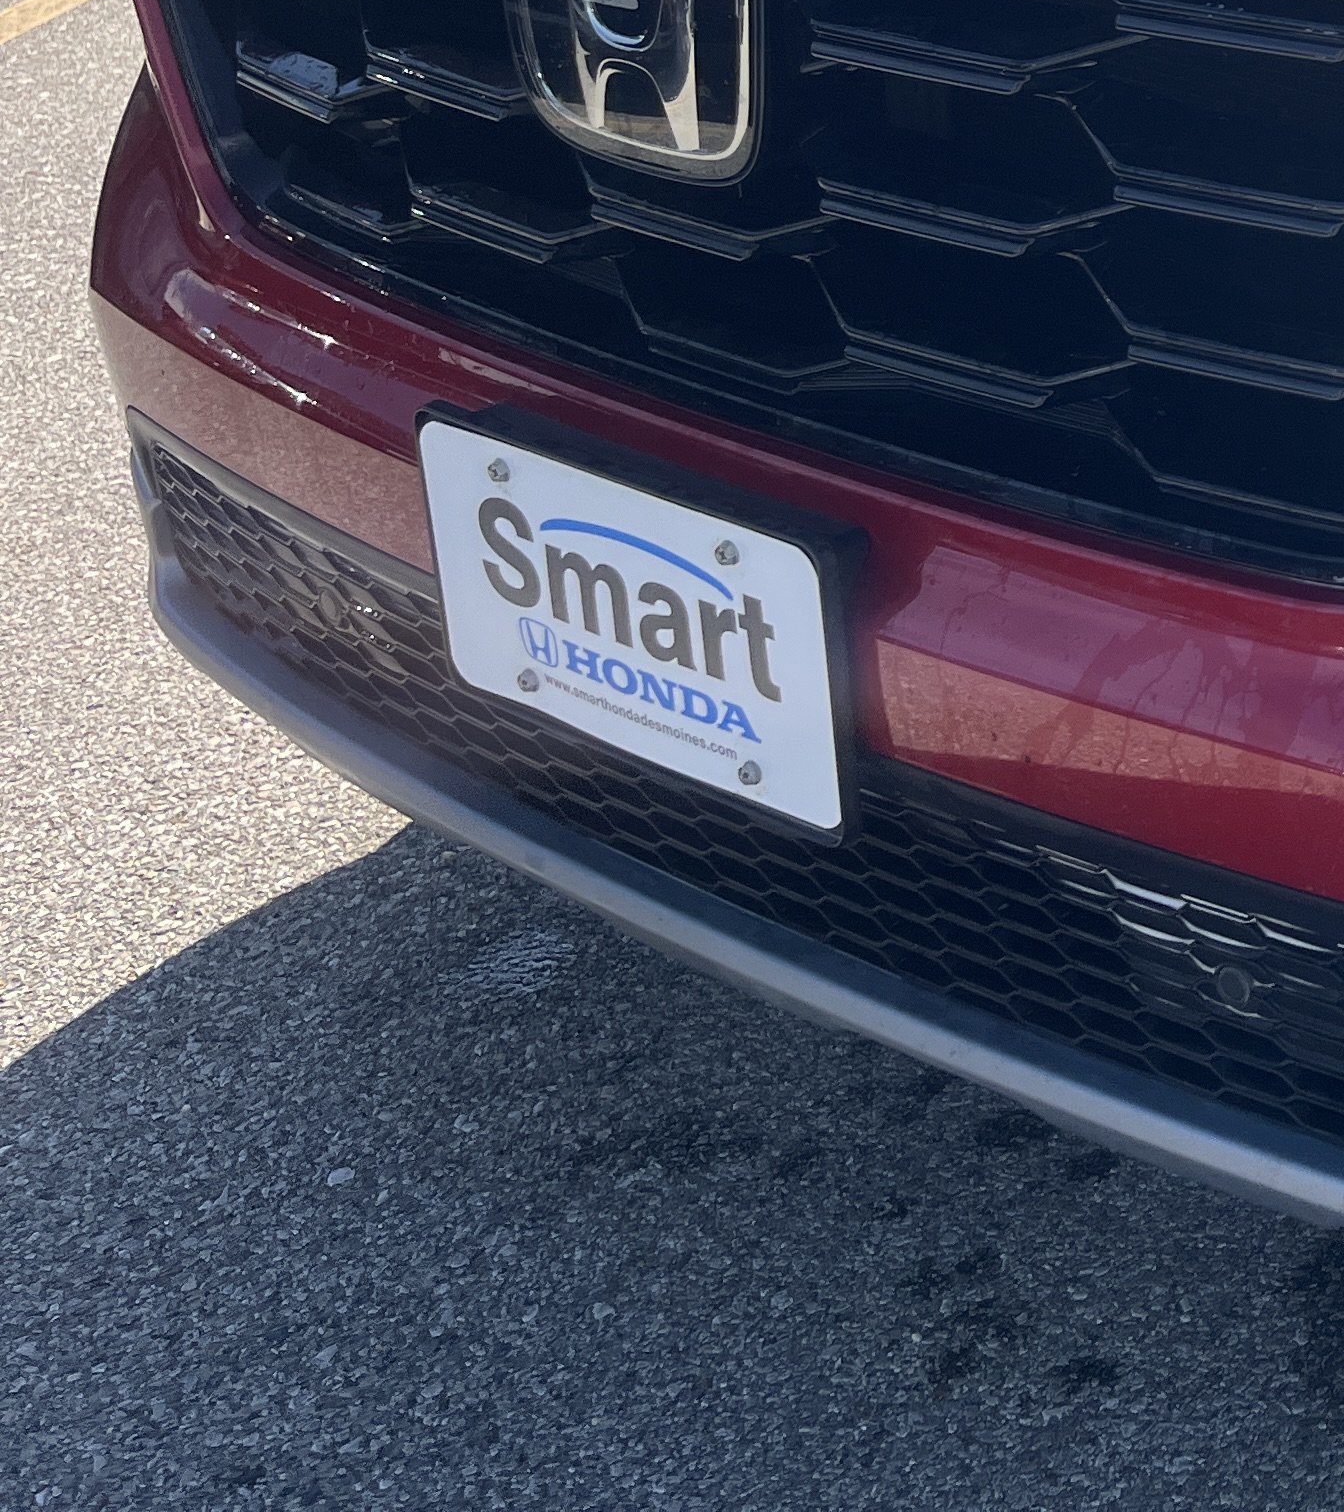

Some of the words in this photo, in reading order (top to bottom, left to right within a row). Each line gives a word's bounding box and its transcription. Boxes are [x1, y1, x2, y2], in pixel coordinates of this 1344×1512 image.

[478, 496, 782, 703] Smart
[544, 673, 738, 760] www.smarthondadesmoines.com
[562, 639, 762, 744] HONDA
